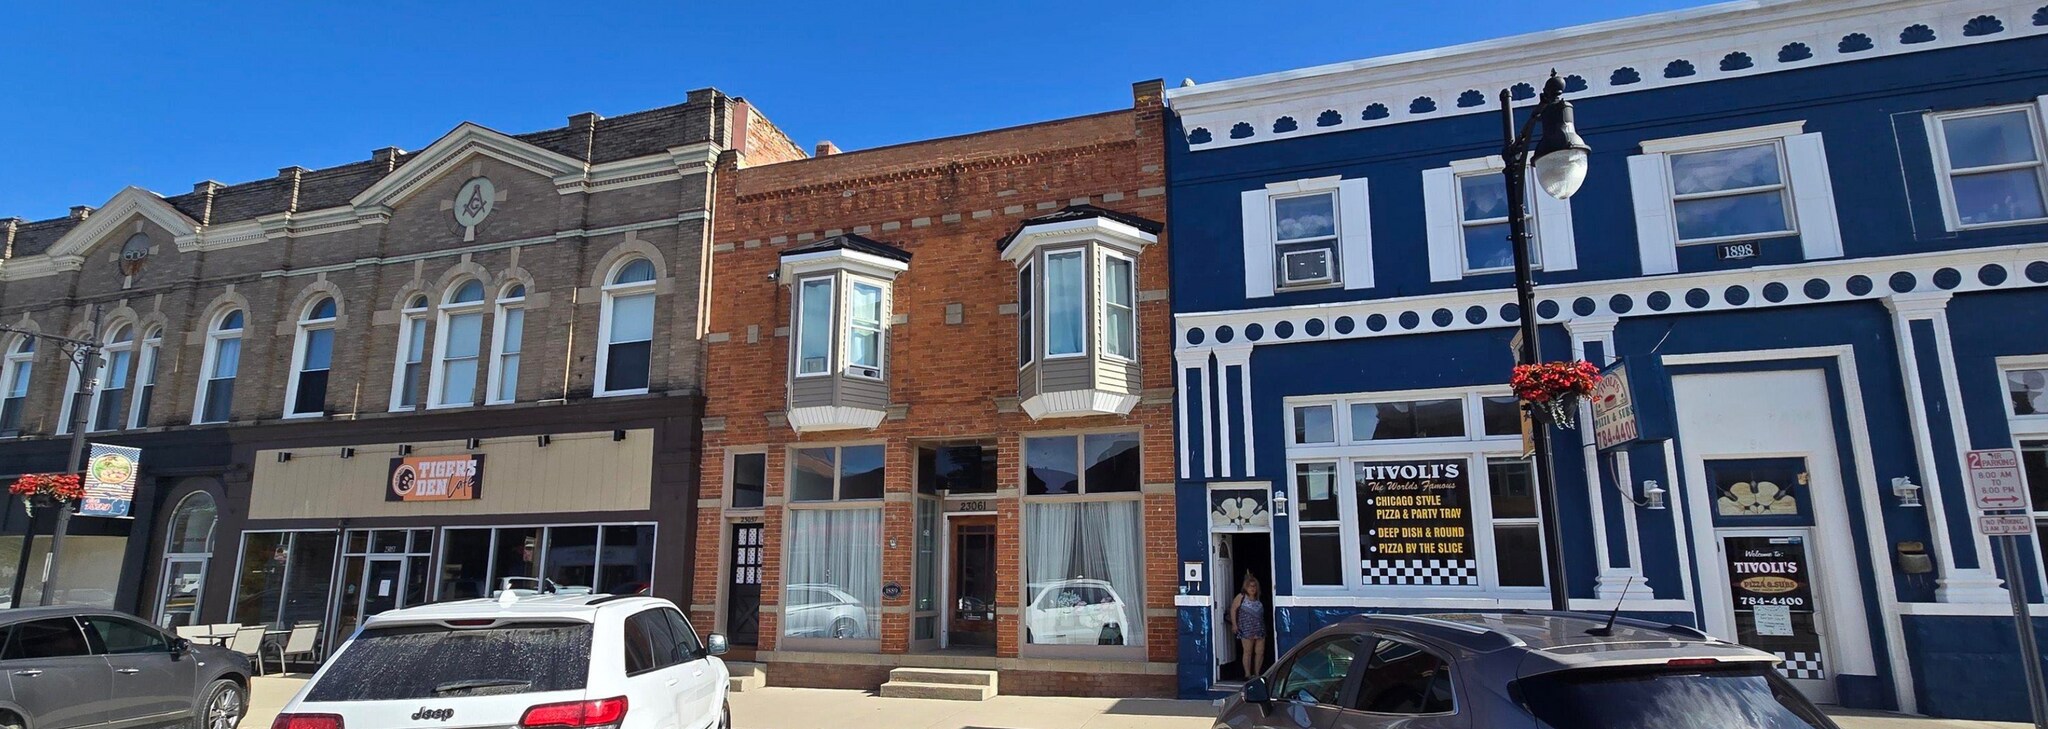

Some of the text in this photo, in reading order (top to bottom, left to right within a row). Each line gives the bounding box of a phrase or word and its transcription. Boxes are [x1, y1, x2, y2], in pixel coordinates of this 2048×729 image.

[1724, 243, 1754, 259] 1898
[1969, 453, 1982, 469] 2
[1982, 459, 2015, 467] PARKING
[418, 460, 477, 478] TIGERS
[1362, 463, 1460, 480] TIVOLI'S
[416, 479, 447, 496] DEN
[1368, 480, 1456, 492] The Worlds Famous
[960, 501, 987, 511] 23061
[1375, 495, 1441, 507] CHICAGO STYLE
[1376, 508, 1462, 520] PIZZA & PARTY TRAY
[1378, 527, 1465, 538] DEEP DISH & ROUND
[1379, 542, 1464, 554] PIZZA BY THE SLICE
[1734, 561, 1798, 574] TIVOLI'S
[1740, 597, 1804, 605] 784-4400
[411, 706, 454, 722] Jeep
